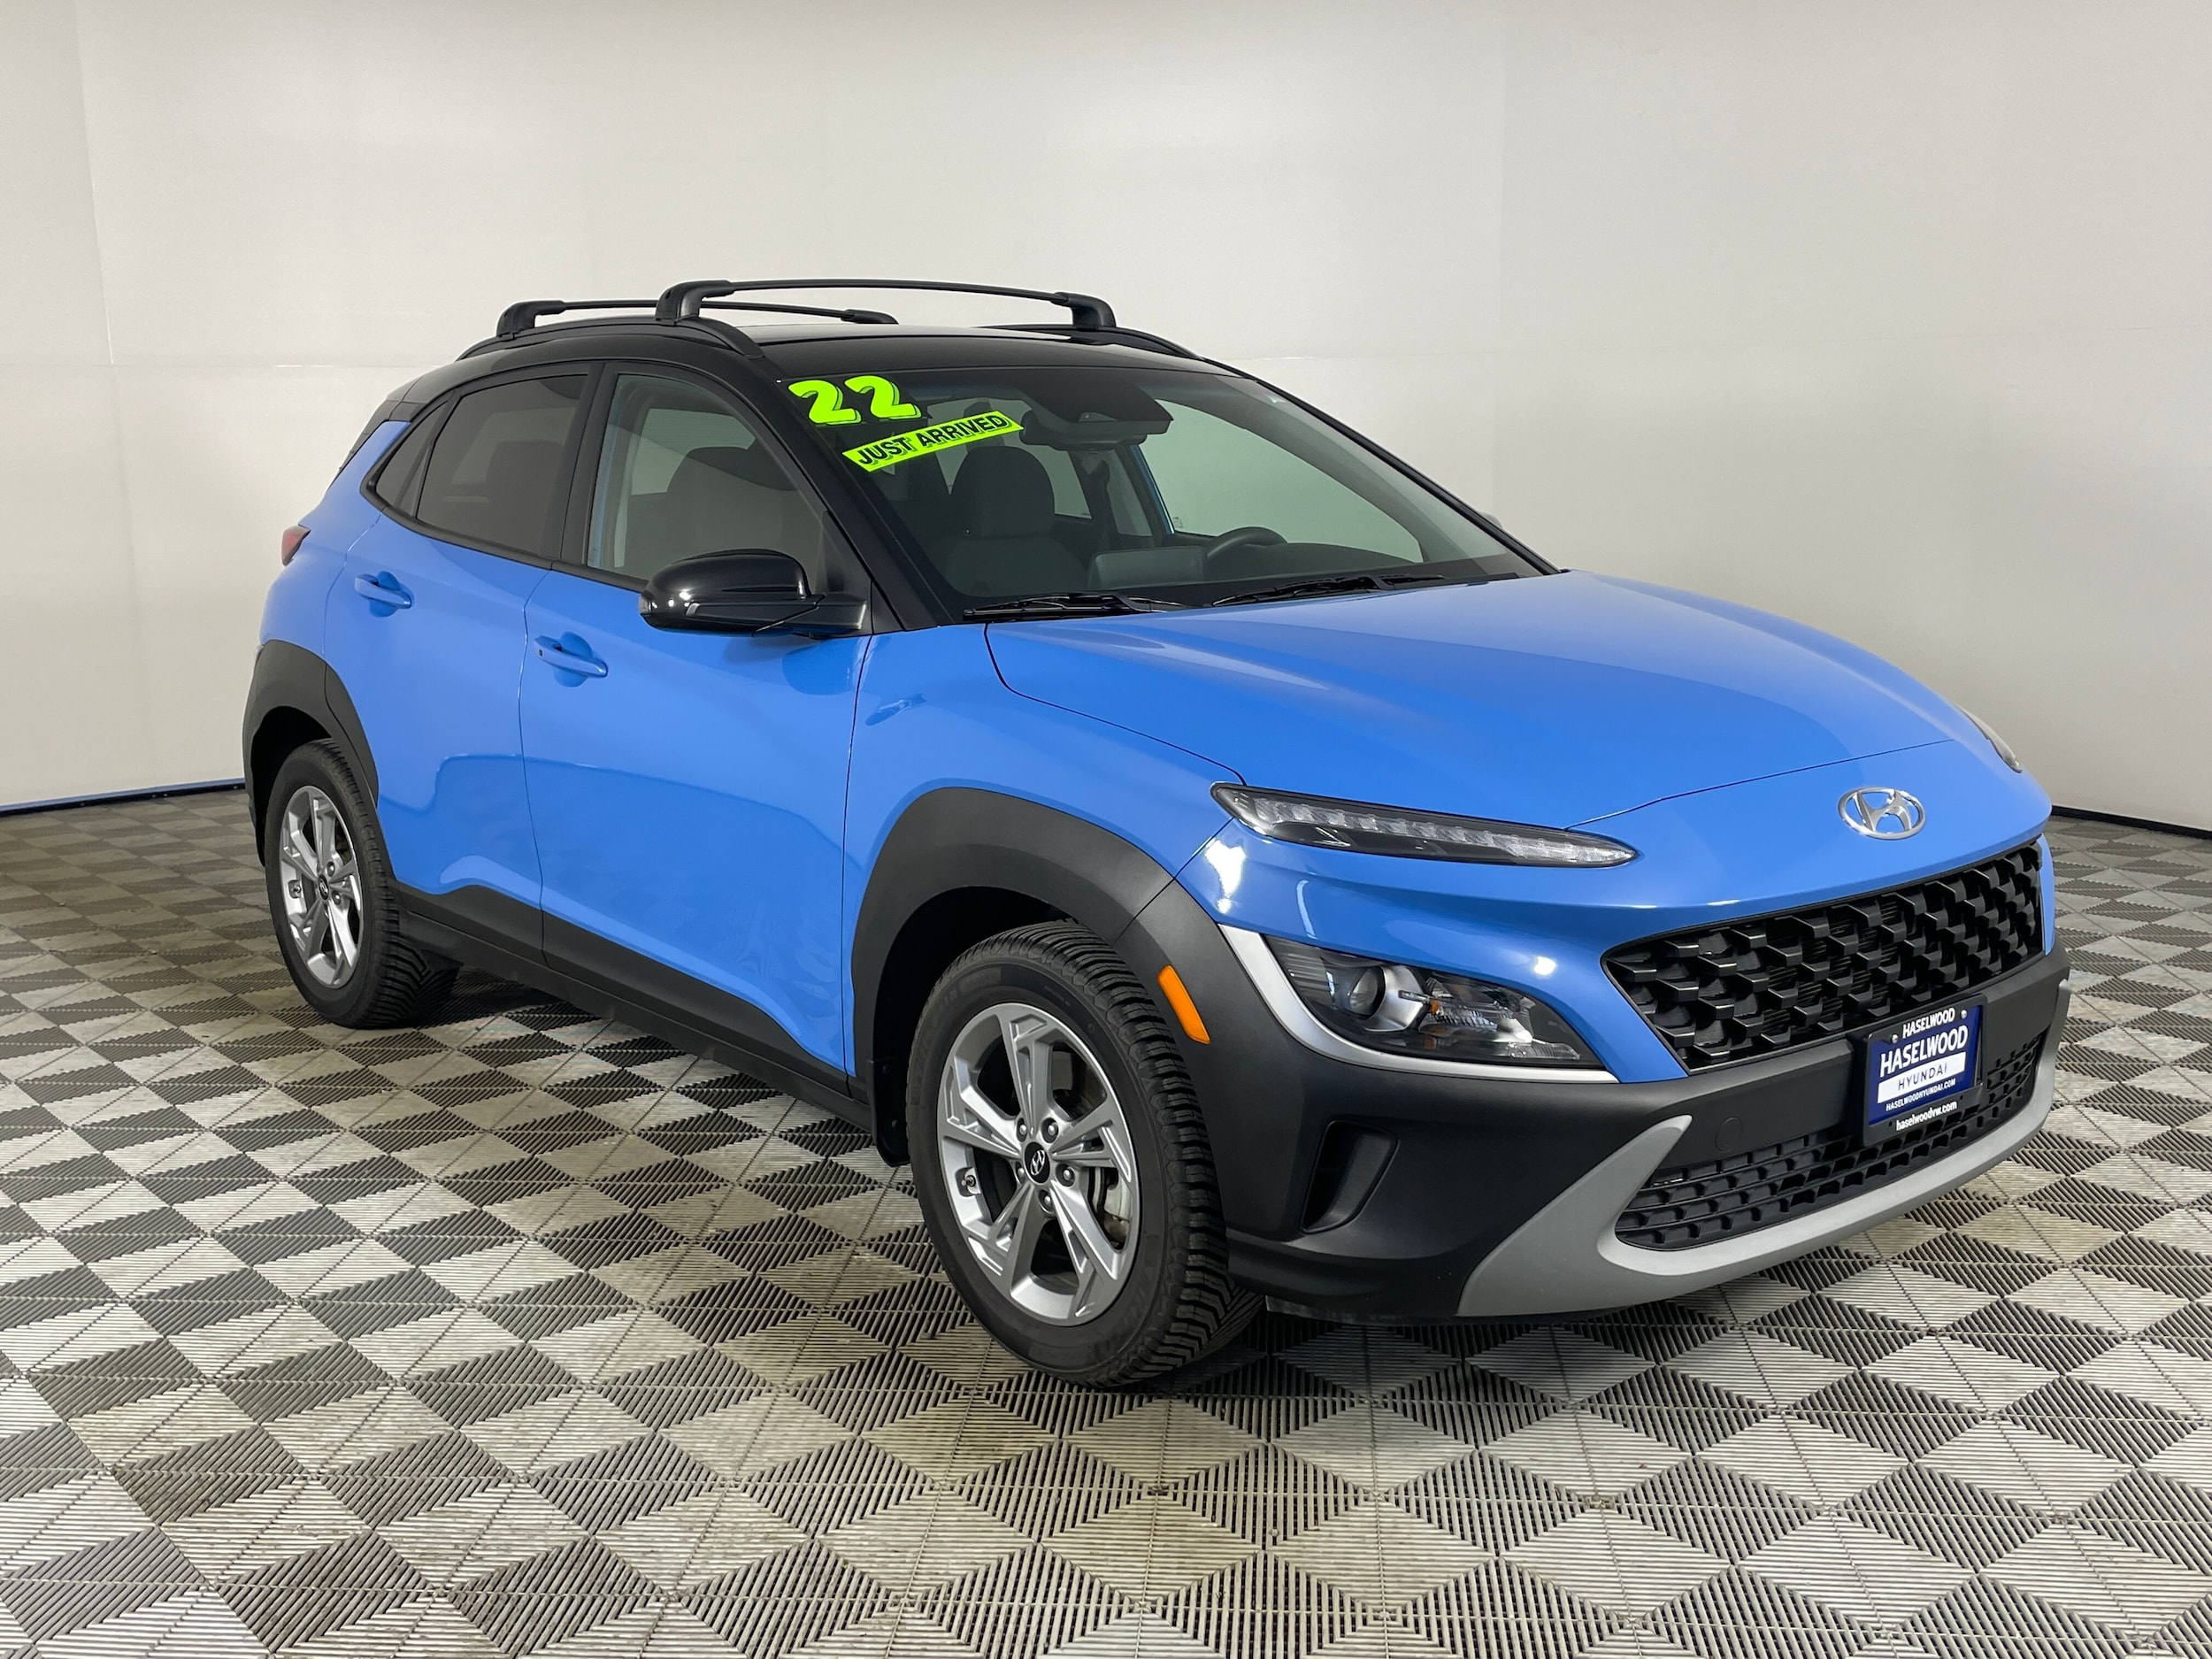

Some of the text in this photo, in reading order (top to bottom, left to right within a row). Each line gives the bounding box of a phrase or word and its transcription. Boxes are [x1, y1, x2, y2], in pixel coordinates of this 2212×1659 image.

[788, 375, 922, 425] 22
[859, 415, 1011, 465] JUST ARRIVED
[1902, 1007, 1955, 1039] HASELWOOD
[1879, 1025, 1969, 1078] HASELWOOD
[1898, 1064, 1947, 1091] HYUNDAI
[1886, 1078, 1956, 1111] HASELWOODHYUNDAI.COM
[1896, 1101, 1957, 1131] haselwoodvw.com
